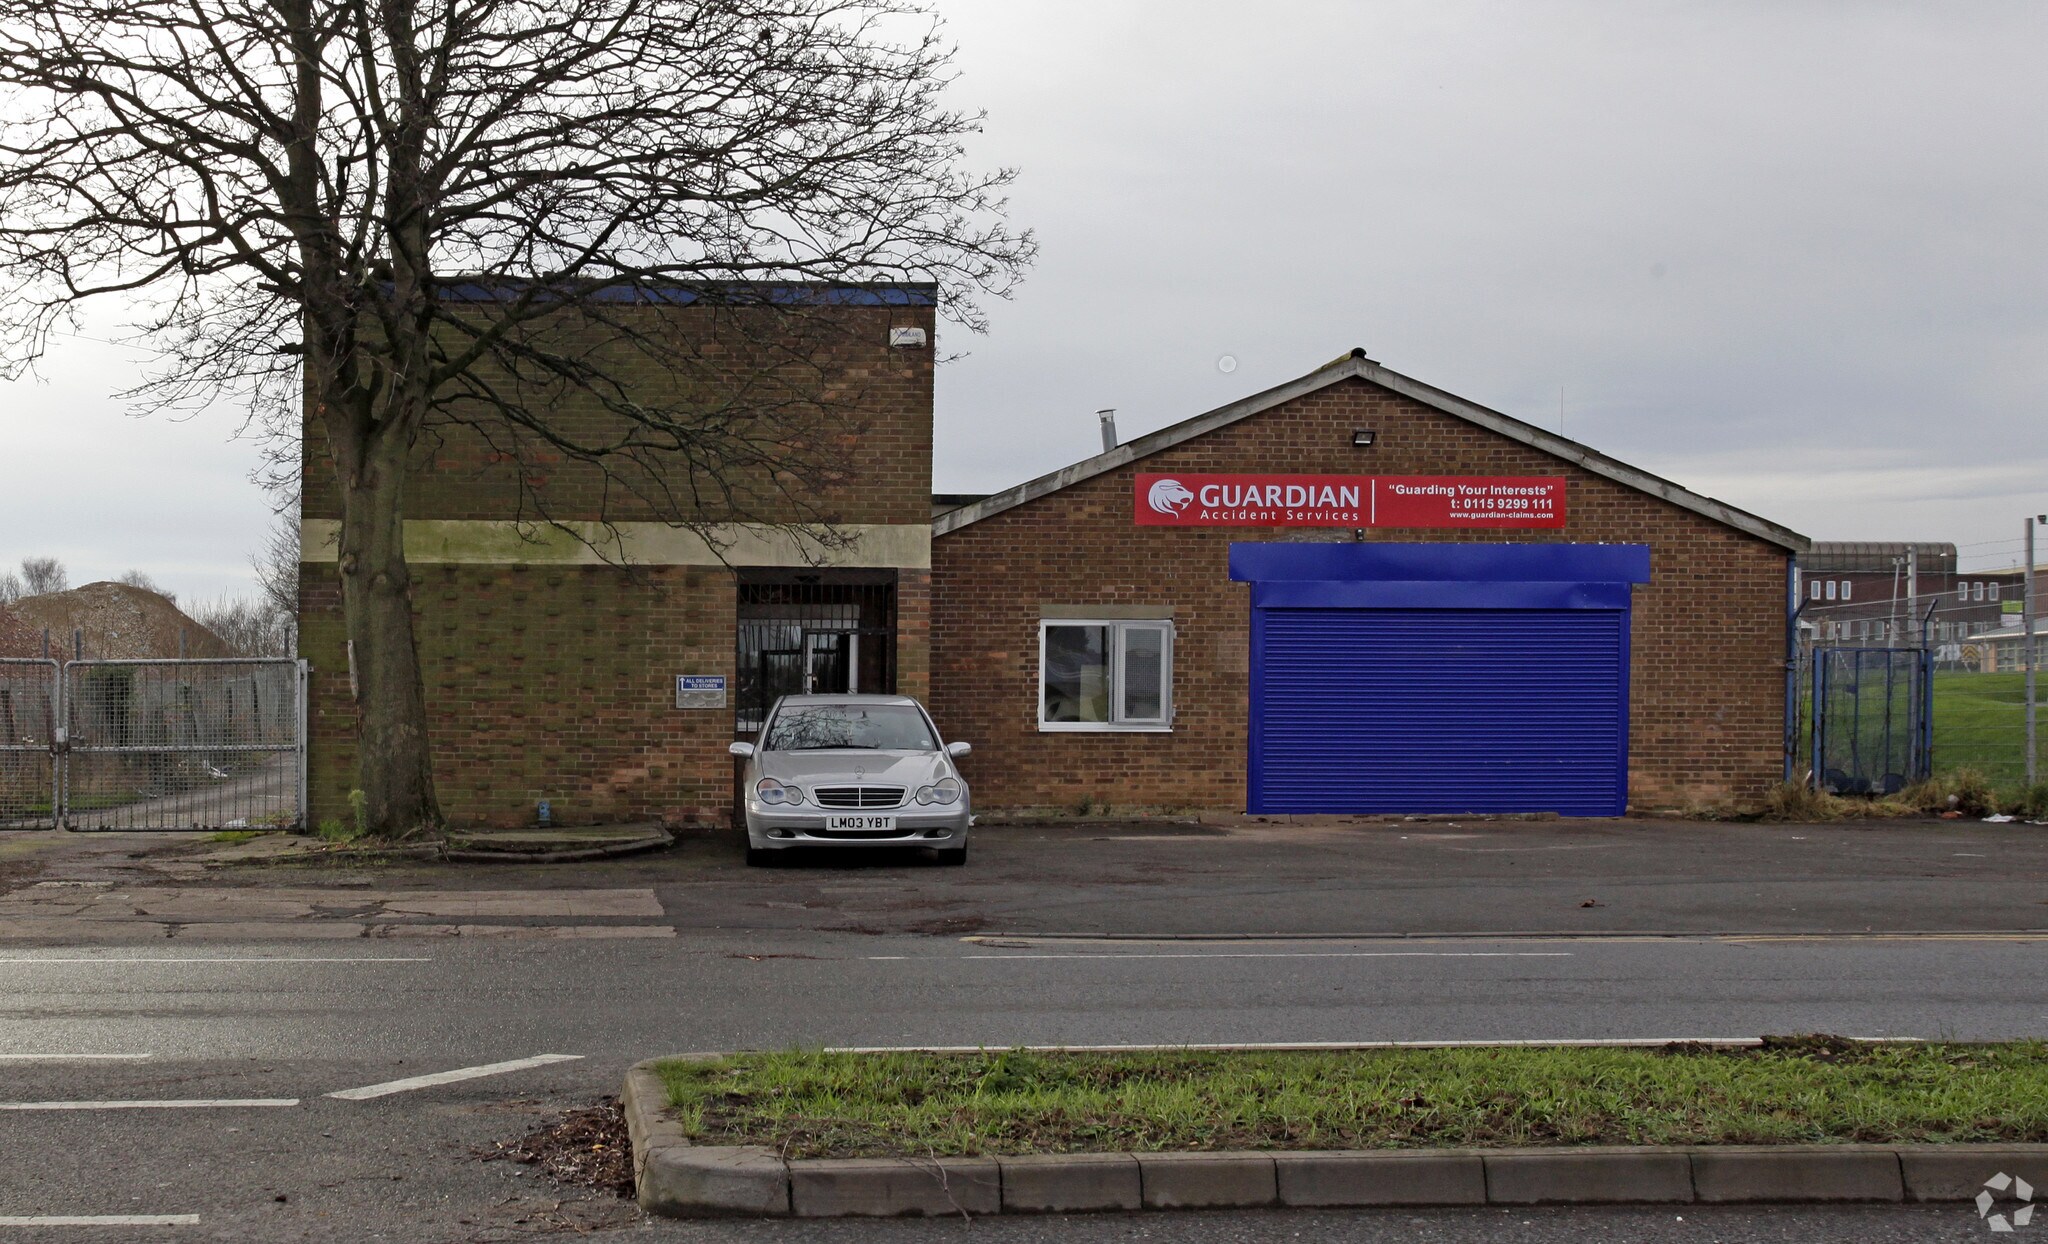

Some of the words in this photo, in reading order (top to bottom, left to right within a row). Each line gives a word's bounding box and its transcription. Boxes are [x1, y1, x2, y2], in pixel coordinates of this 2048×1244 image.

[1199, 484, 1359, 508] GUARDIAN
[1388, 484, 1455, 497] “Guarding
[1457, 484, 1488, 496] Your
[1490, 485, 1553, 496] Interests”
[1450, 499, 1461, 509] t:
[1463, 498, 1495, 509] 0115
[1497, 499, 1528, 509] 9299
[1532, 499, 1553, 509] 111
[1200, 509, 1277, 520] Accident
[1286, 510, 1359, 521] Services
[1449, 511, 1554, 519] www.guardian-claims.com
[831, 817, 864, 828] LM03
[867, 817, 891, 828] YBT
